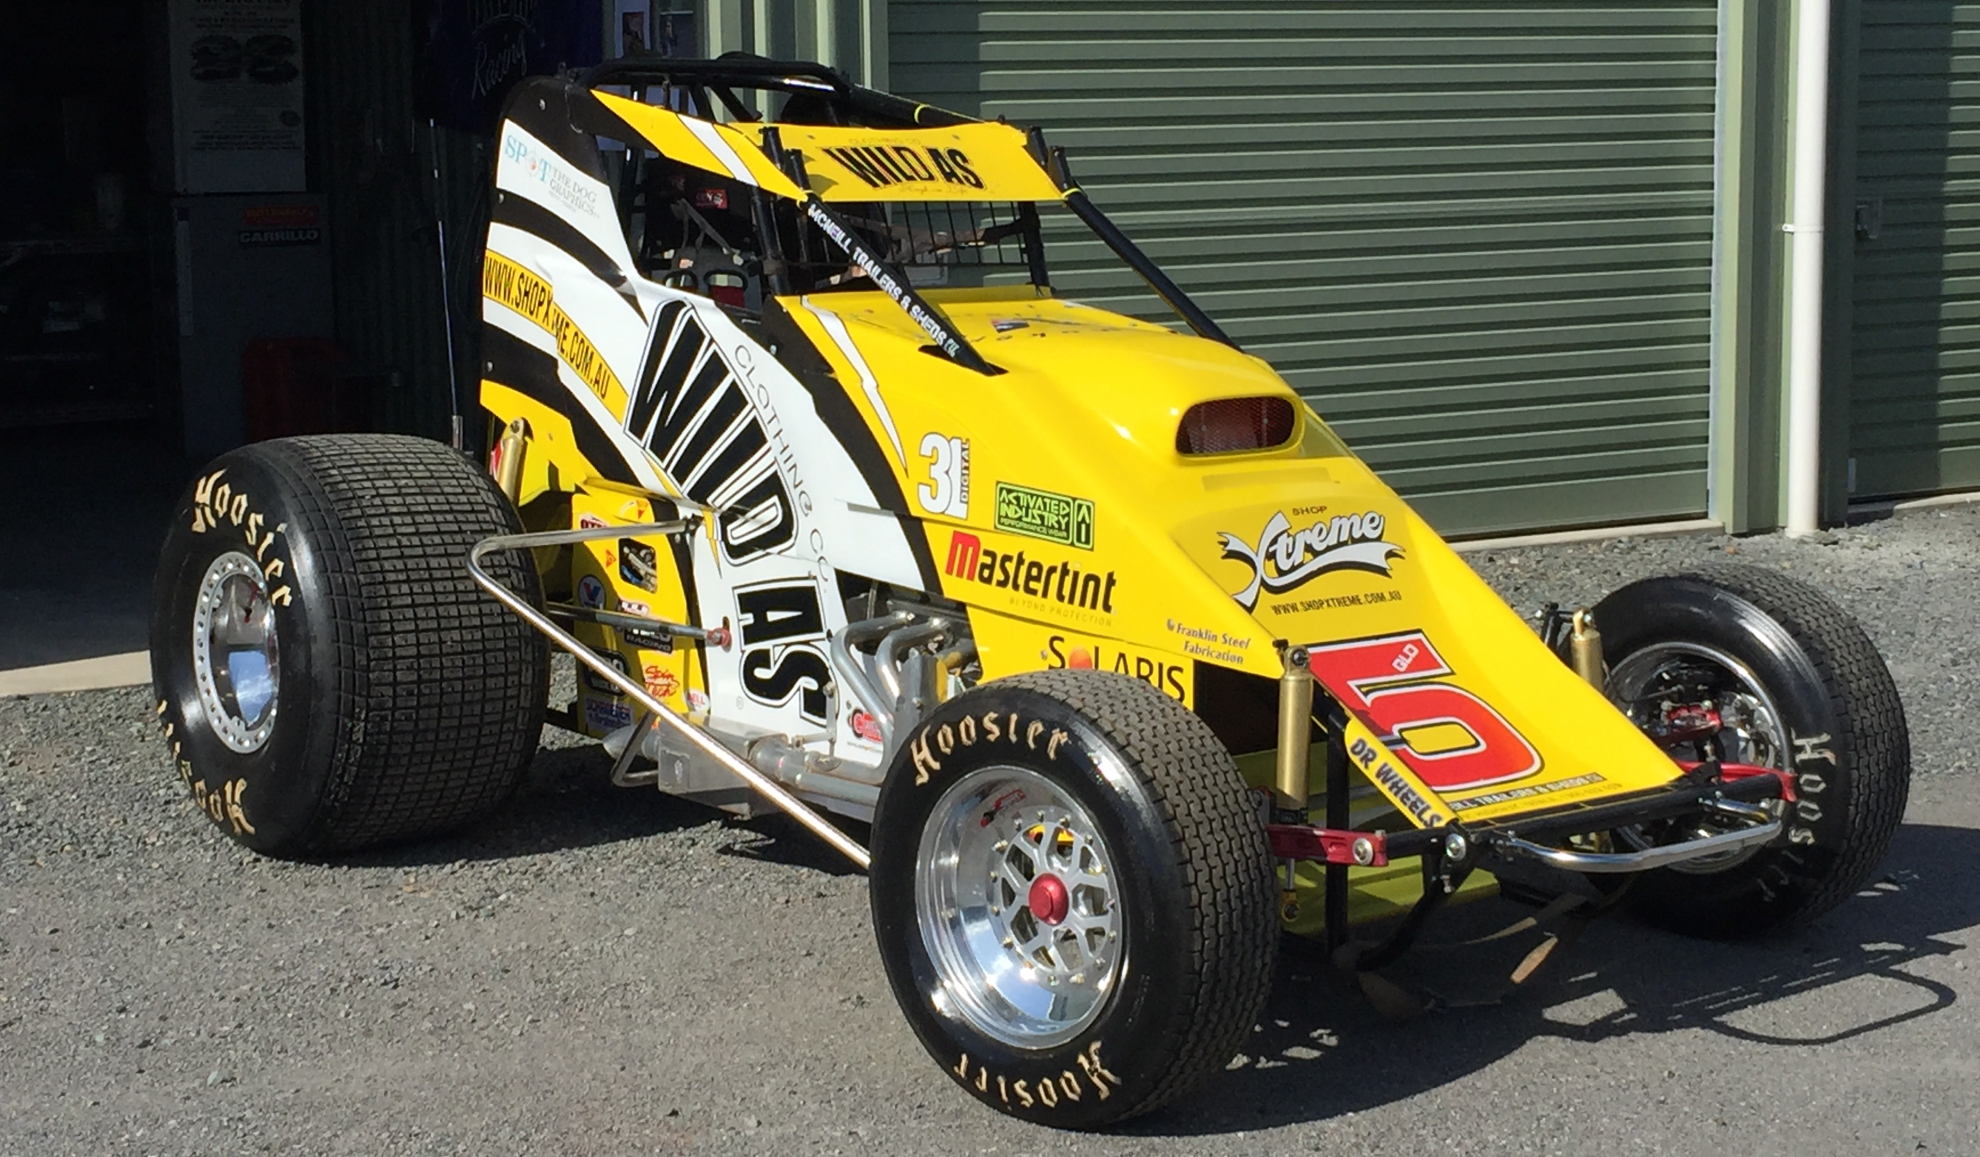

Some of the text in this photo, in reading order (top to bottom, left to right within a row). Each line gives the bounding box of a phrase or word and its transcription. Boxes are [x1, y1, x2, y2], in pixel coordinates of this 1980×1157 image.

[552, 167, 571, 188] THE
[573, 182, 597, 204] DOG
[820, 146, 987, 190] WILD AS
[239, 229, 319, 243] CARRILLO
[808, 203, 947, 345] MCNEILL TRAILERS & SHEDS
[735, 345, 812, 517] CLOTHING
[960, 438, 970, 504] DIGITAL
[624, 298, 840, 729] WILD AS
[1000, 489, 1070, 515] ACTIVATED
[1000, 503, 1069, 530] INDUSTRY
[1292, 505, 1328, 516] SHOP
[945, 530, 1117, 614] Mastertint
[1217, 510, 1406, 615] Xtreme
[1009, 596, 1113, 627] BEYOND PROTECTION
[626, 634, 672, 652] RACING
[1176, 622, 1251, 650] Franklin Steel
[1183, 641, 1244, 665] Fabrication
[909, 710, 1070, 787] Hoosier
[1349, 737, 1379, 771] DR
[1375, 762, 1446, 829] WHEELS
